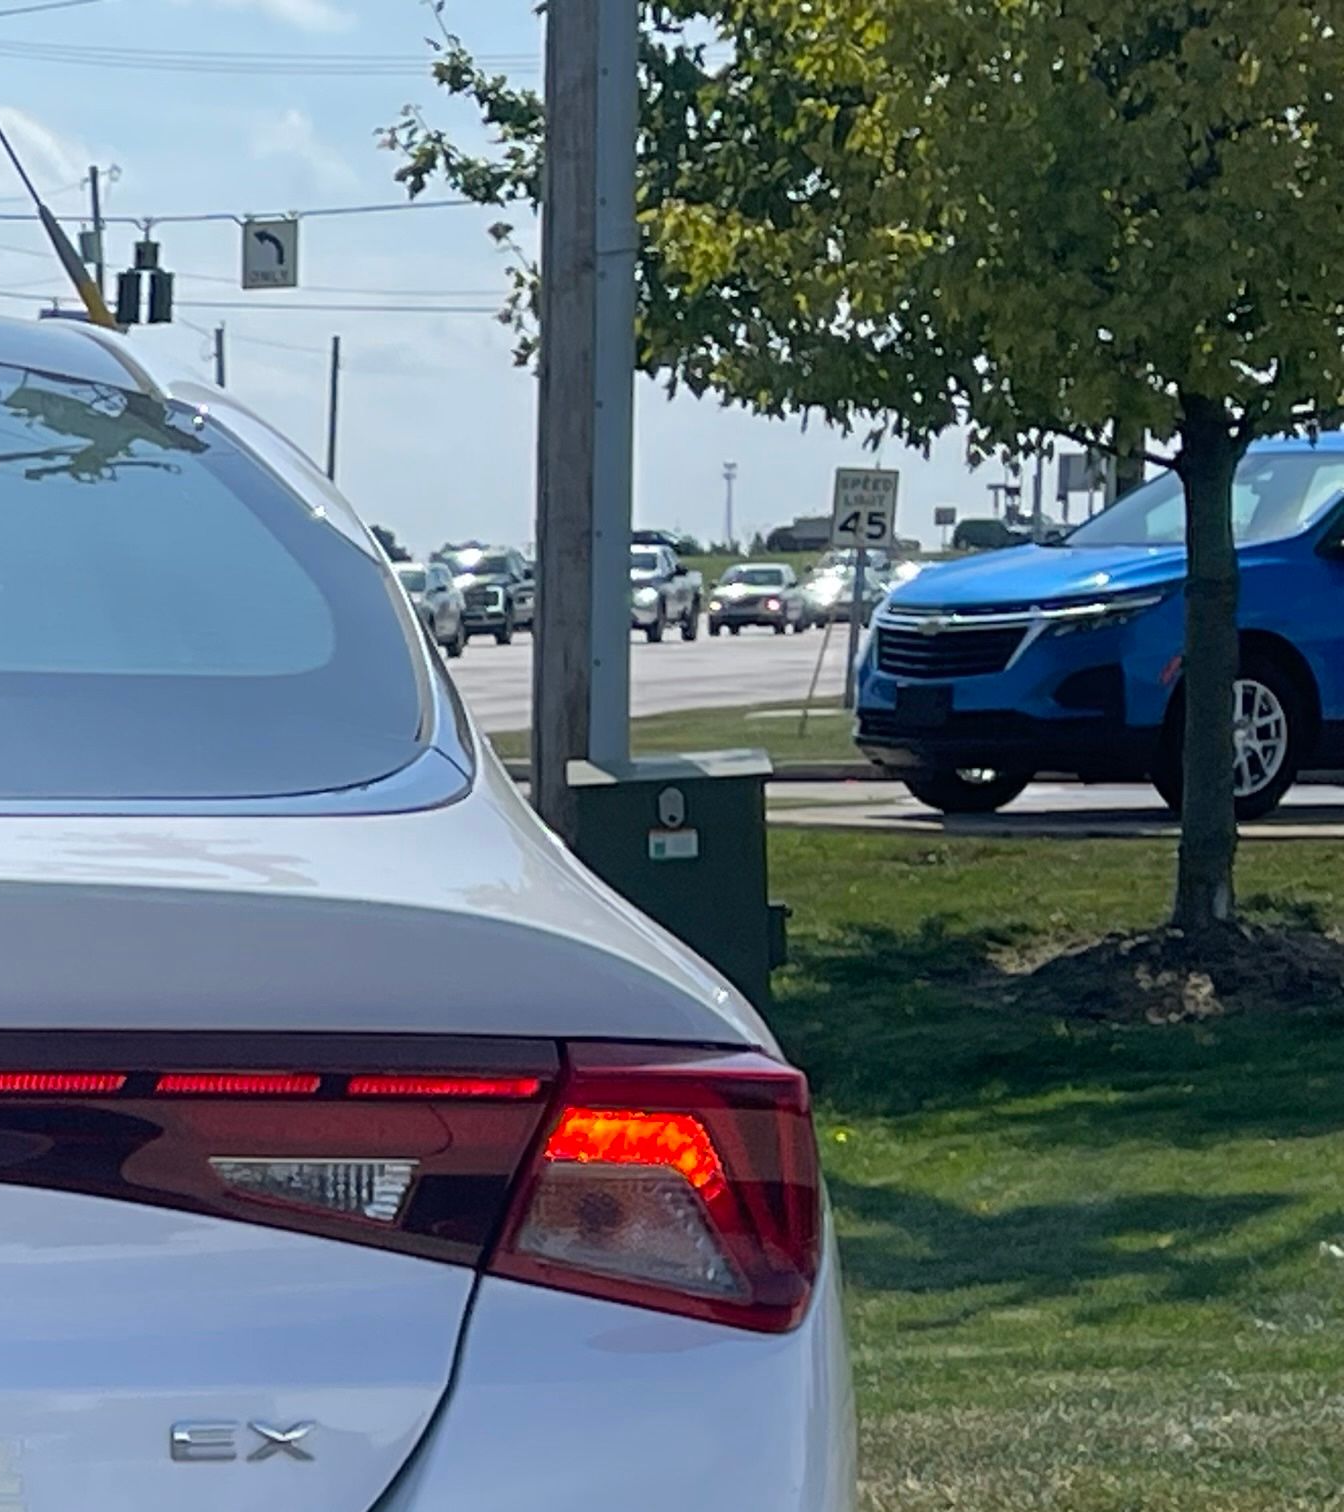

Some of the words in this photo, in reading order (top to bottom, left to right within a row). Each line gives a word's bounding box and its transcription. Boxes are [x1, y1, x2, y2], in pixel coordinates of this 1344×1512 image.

[248, 270, 288, 283] ONLY
[840, 476, 893, 492] SPEED
[844, 494, 886, 506] LIMIT
[838, 511, 887, 540] 45
[170, 1418, 317, 1463] EX
